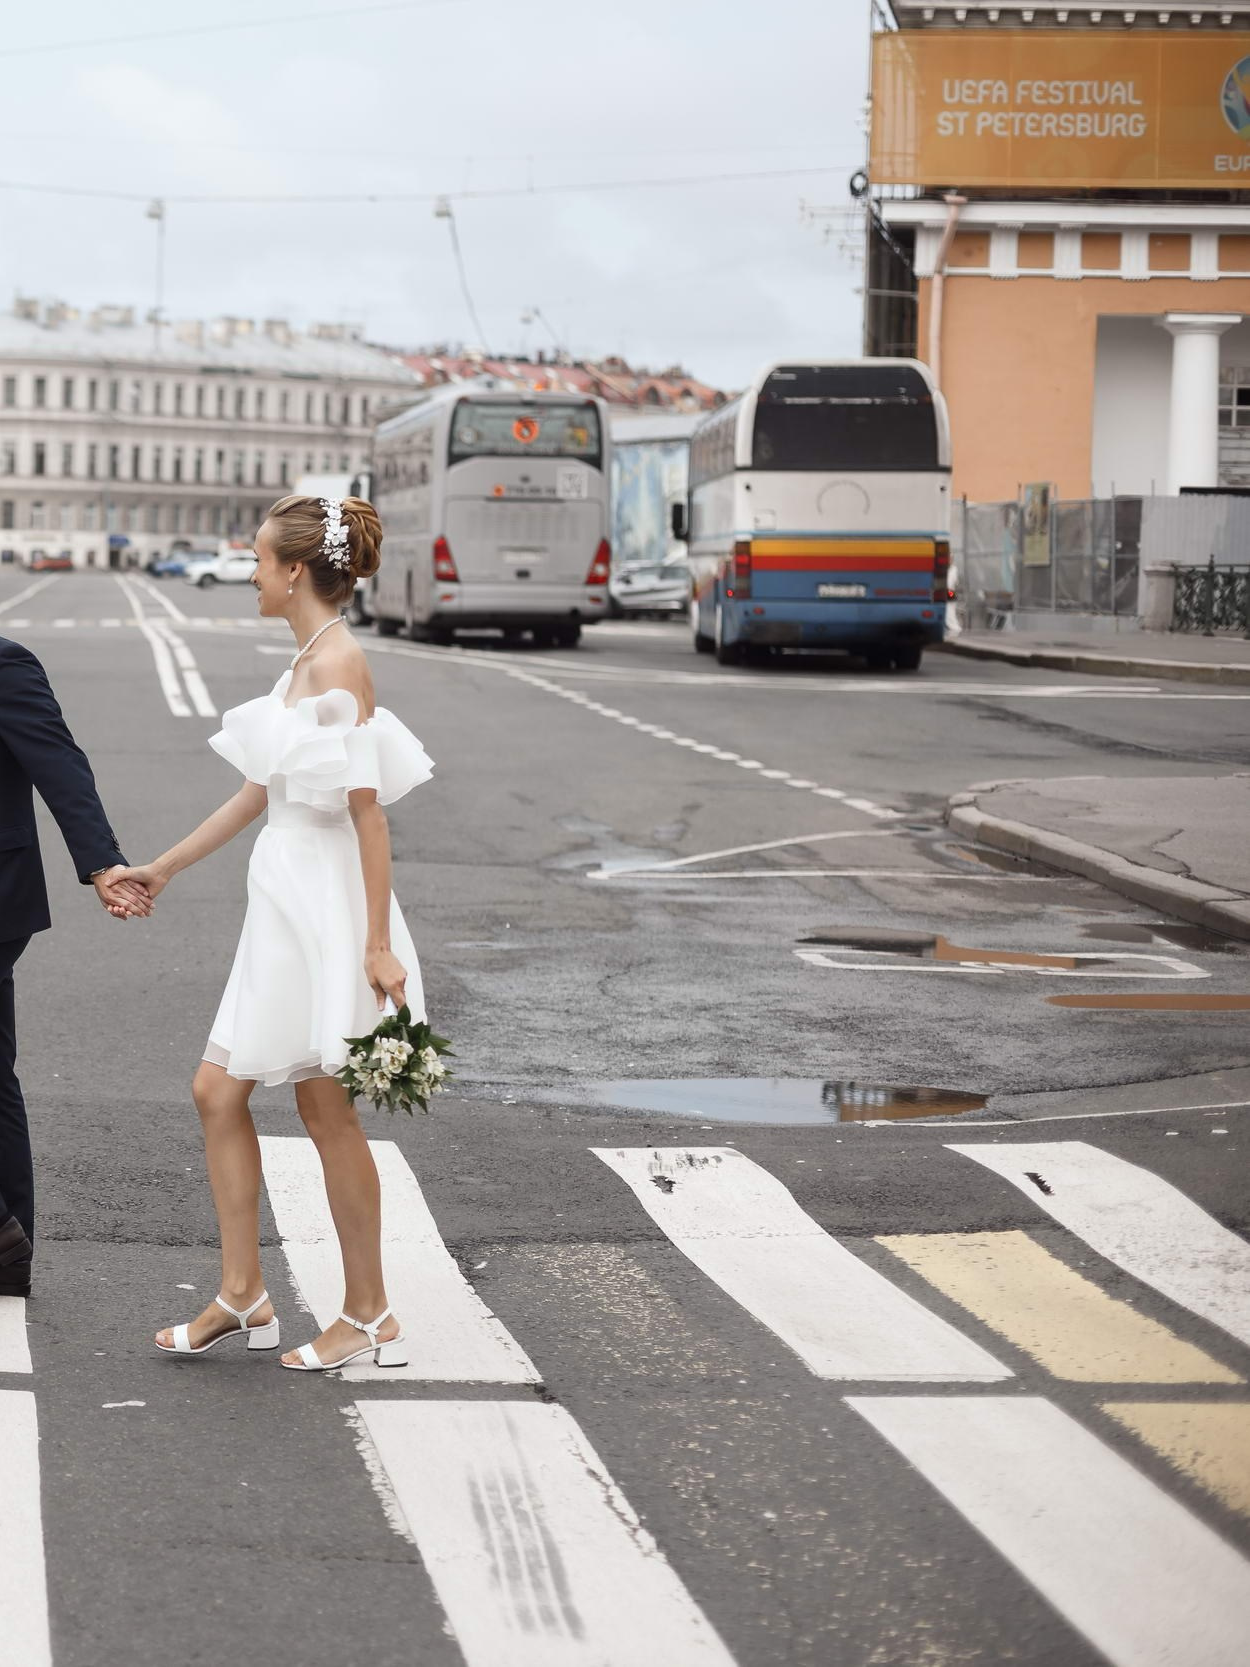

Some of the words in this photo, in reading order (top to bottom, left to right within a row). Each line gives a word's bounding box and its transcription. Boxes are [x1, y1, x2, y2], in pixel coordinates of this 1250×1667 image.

[943, 79, 1008, 105] UEFA
[1016, 80, 1143, 105] FESTIVAL
[937, 112, 969, 137] ST
[976, 112, 1147, 138] PETERSBURG
